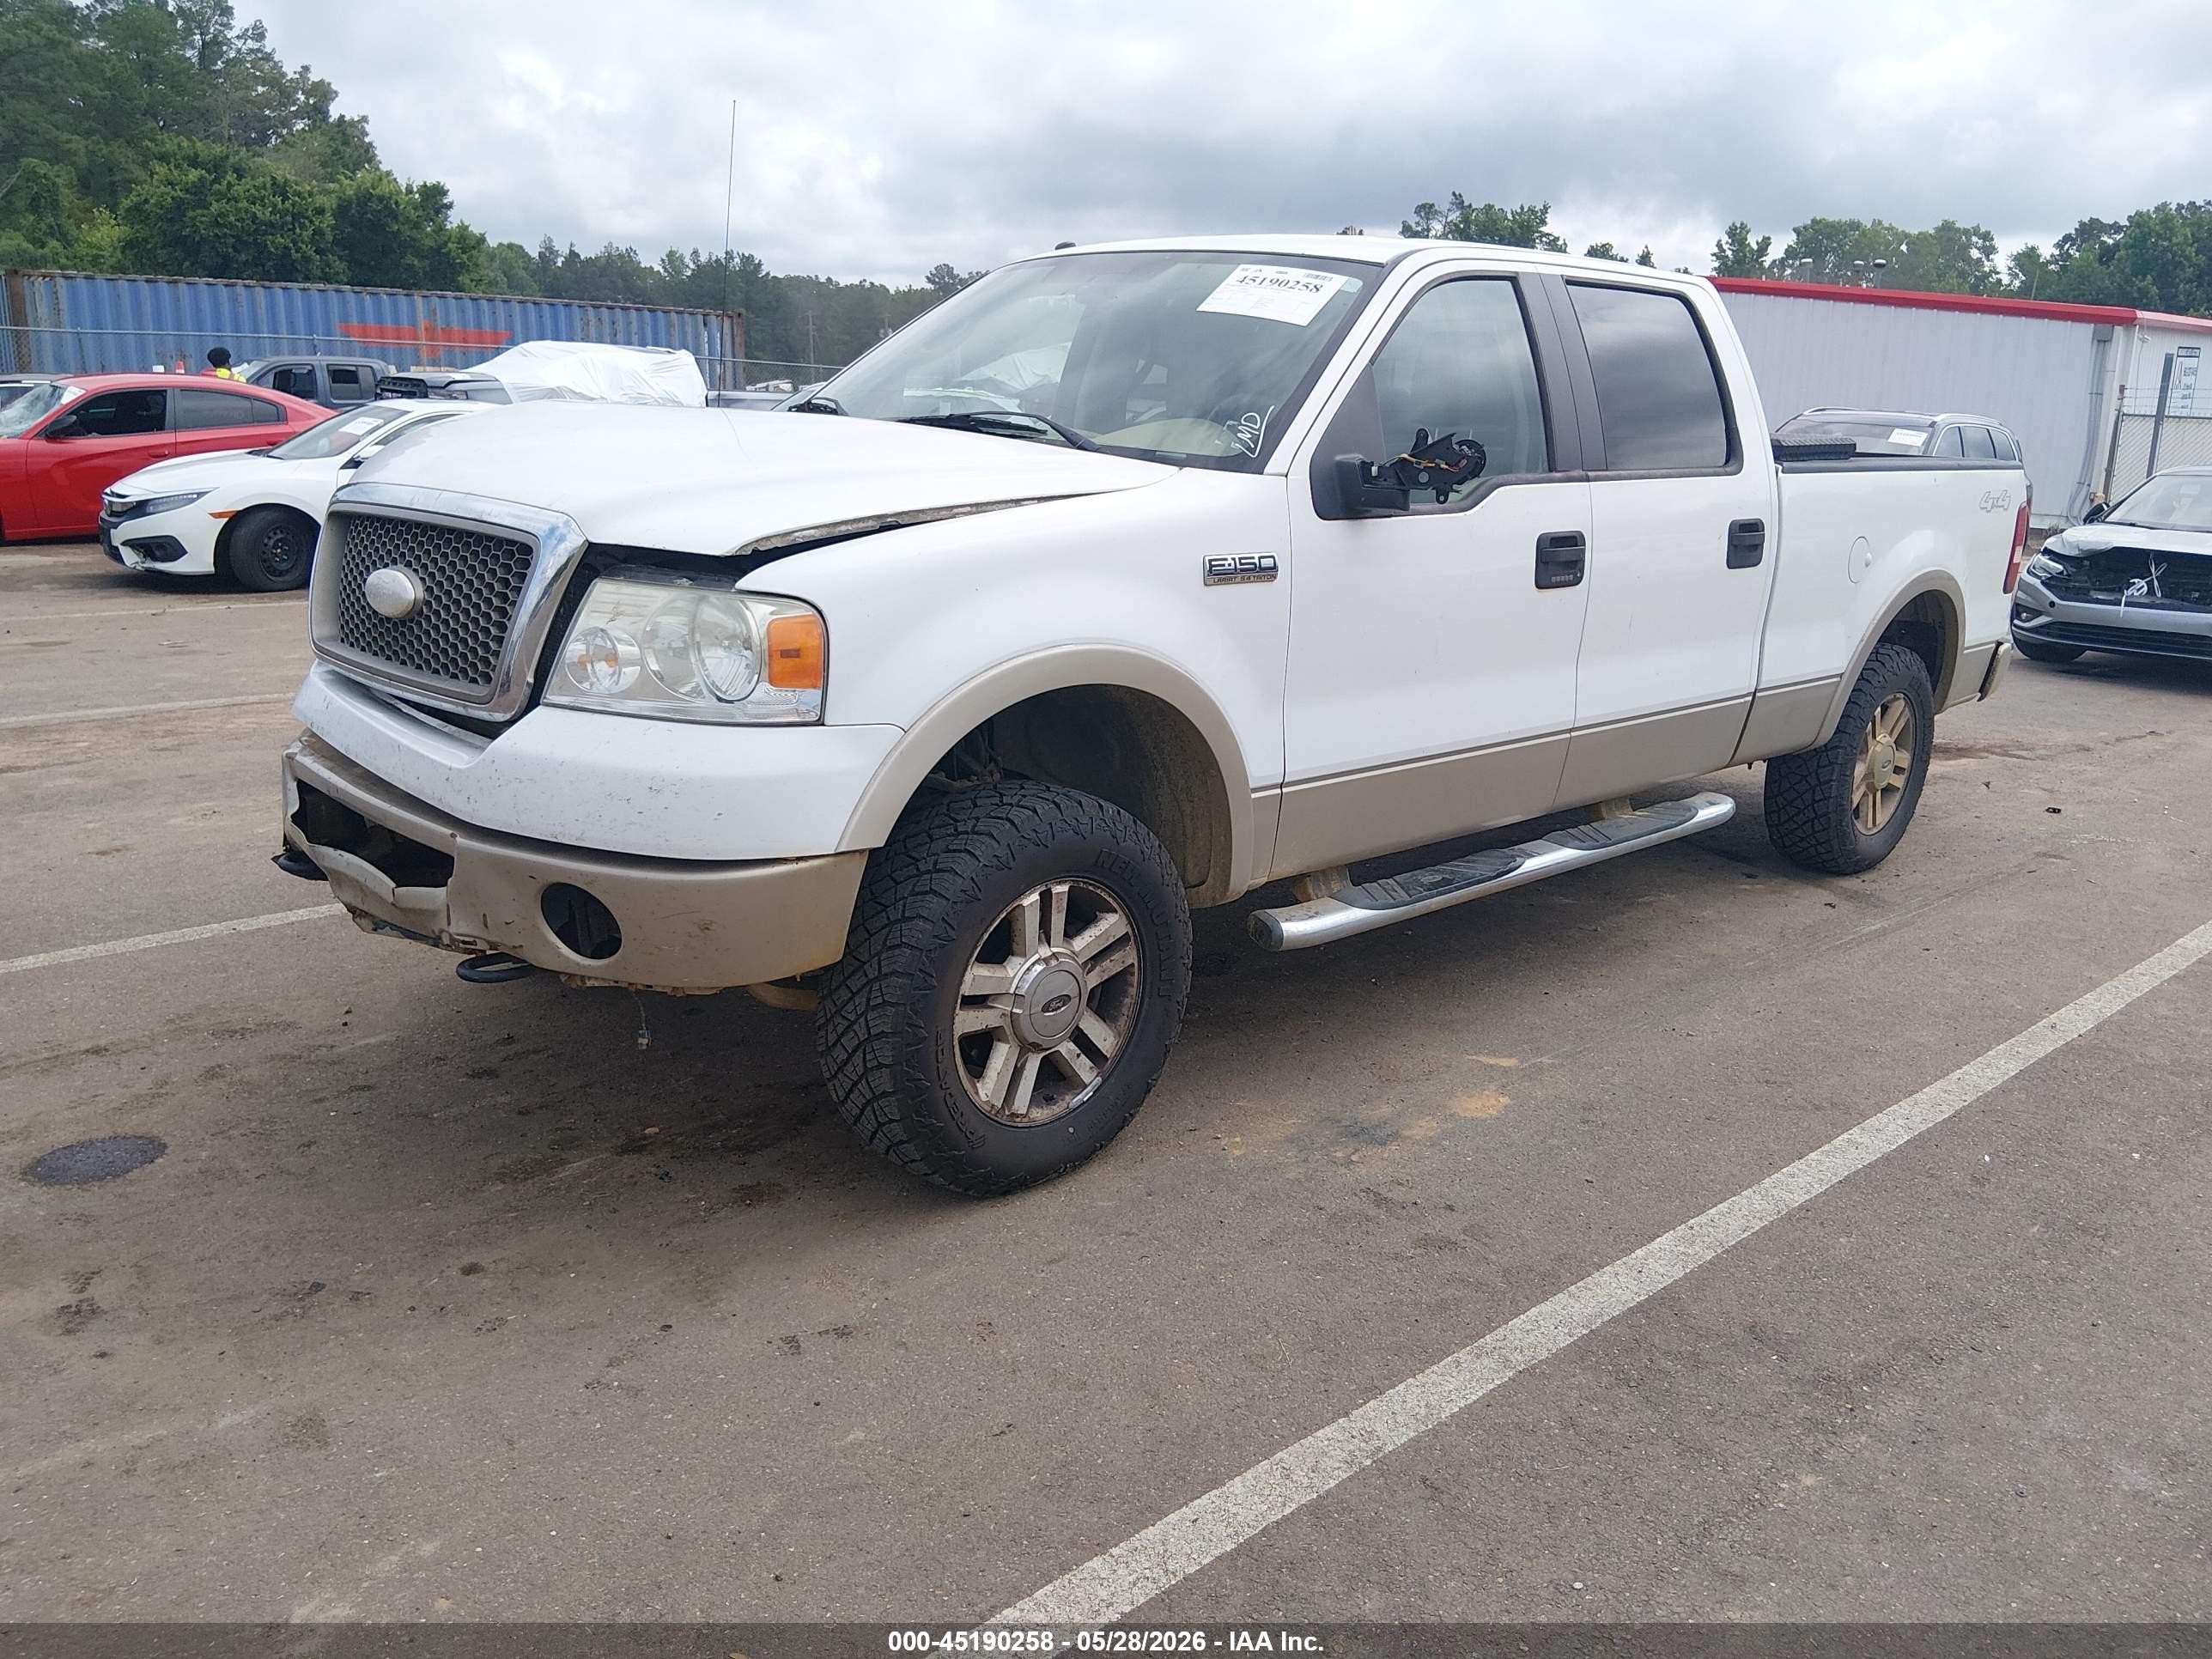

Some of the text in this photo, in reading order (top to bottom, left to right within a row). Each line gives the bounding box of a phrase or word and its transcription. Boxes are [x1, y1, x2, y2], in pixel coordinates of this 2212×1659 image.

[1236, 275, 1324, 294] 45190258
[1979, 489, 2012, 514] 4x4
[1207, 555, 1277, 575] F-150
